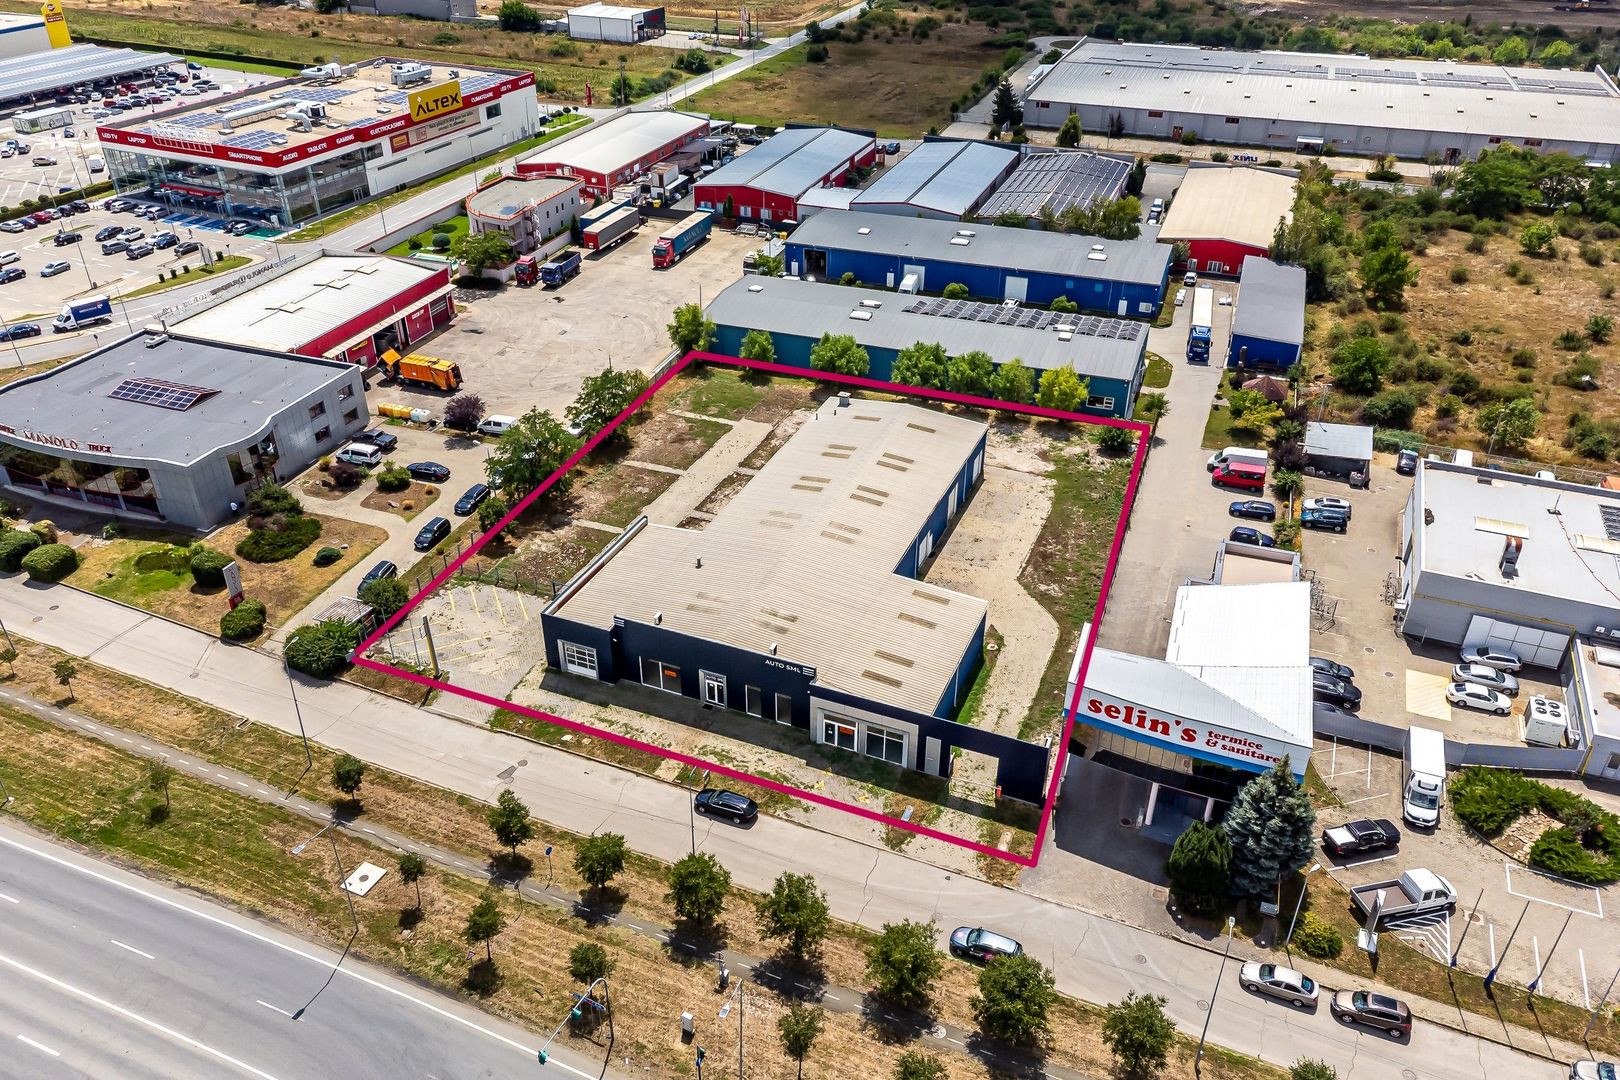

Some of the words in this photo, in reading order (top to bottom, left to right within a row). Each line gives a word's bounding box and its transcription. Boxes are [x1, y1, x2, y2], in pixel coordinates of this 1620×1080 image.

[336, 133, 355, 145] GAMING
[282, 152, 299, 162] AUDIO
[23, 430, 78, 450] MANOLO
[87, 443, 112, 454] TRUCK
[764, 659, 785, 669] AUTO
[786, 664, 802, 674] SML
[1087, 697, 1198, 743] selin's
[1207, 729, 1264, 750] termice
[1205, 738, 1218, 748] &
[1220, 741, 1281, 764] sanitare
